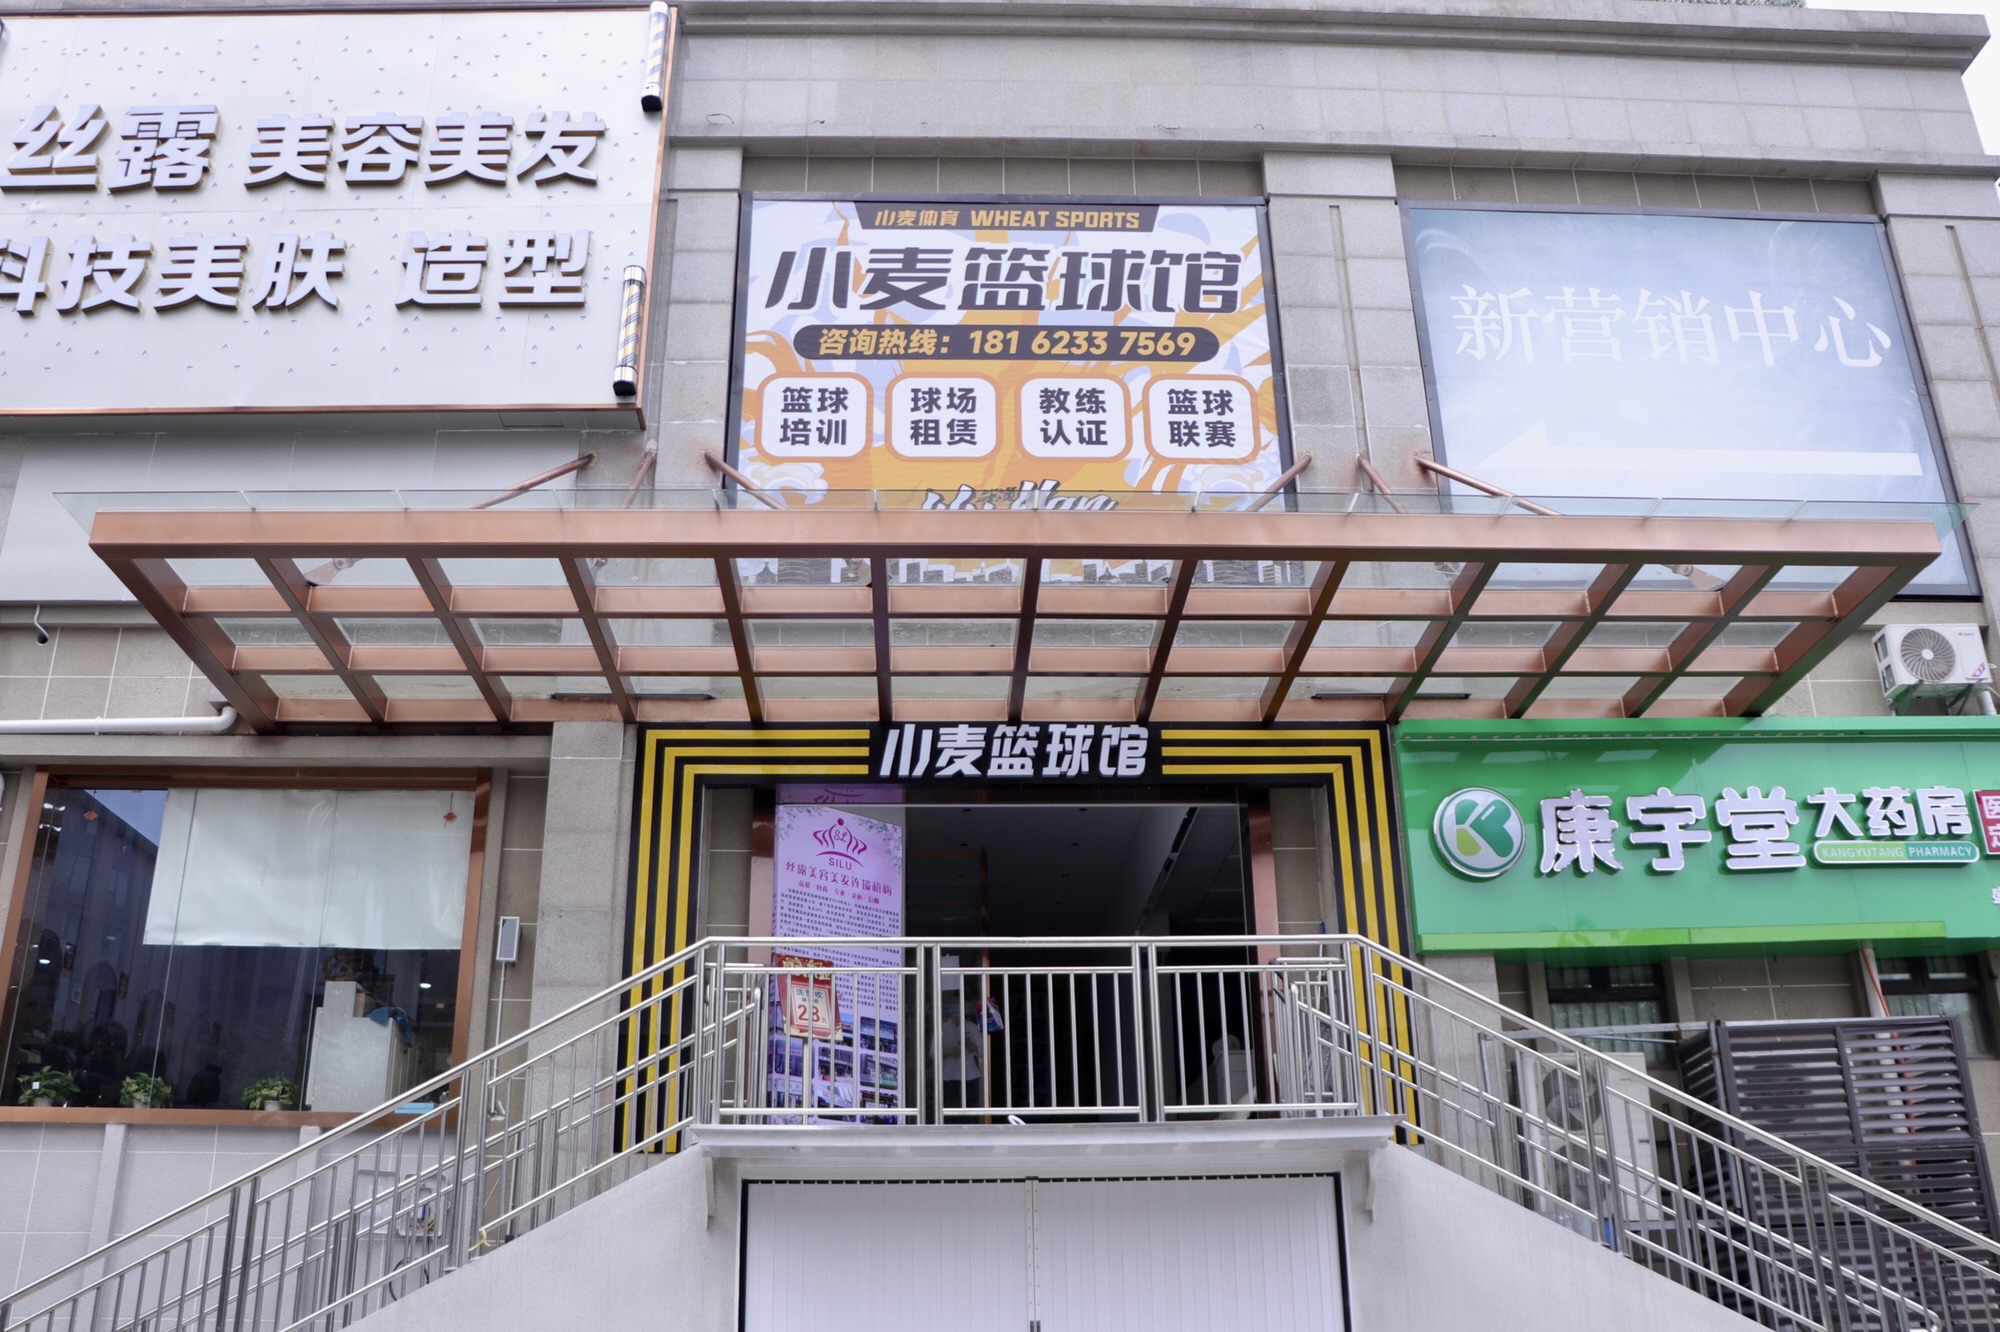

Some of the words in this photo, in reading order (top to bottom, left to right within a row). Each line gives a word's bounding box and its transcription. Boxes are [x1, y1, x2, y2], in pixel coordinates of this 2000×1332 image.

[0, 105, 218, 192] 丝露
[243, 111, 606, 189] 美容美发
[875, 210, 959, 226] 小麦体育
[971, 210, 1049, 227] WHEAT
[1055, 211, 1140, 228] SPORTS
[395, 228, 592, 308] 造型
[765, 246, 1241, 314] 小麦篮球馆
[1449, 284, 1891, 368] 新营销中心
[969, 330, 1019, 354] 181
[1031, 330, 1108, 355] 6233
[1119, 331, 1196, 356] 7569
[781, 387, 849, 414] 篮球
[910, 387, 977, 414] 球场
[1039, 388, 1107, 415] 教练
[1167, 388, 1235, 416] 篮球
[780, 418, 848, 446] 培训
[910, 419, 978, 447] 租赁
[1039, 419, 1108, 447] 认证
[1168, 419, 1237, 448] 联赛
[879, 723, 1148, 778] 小麦篮球馆
[828, 857, 852, 871] SILU
[1822, 847, 1904, 858] KANGYUTANG
[1909, 846, 1972, 857] PHARMACY
